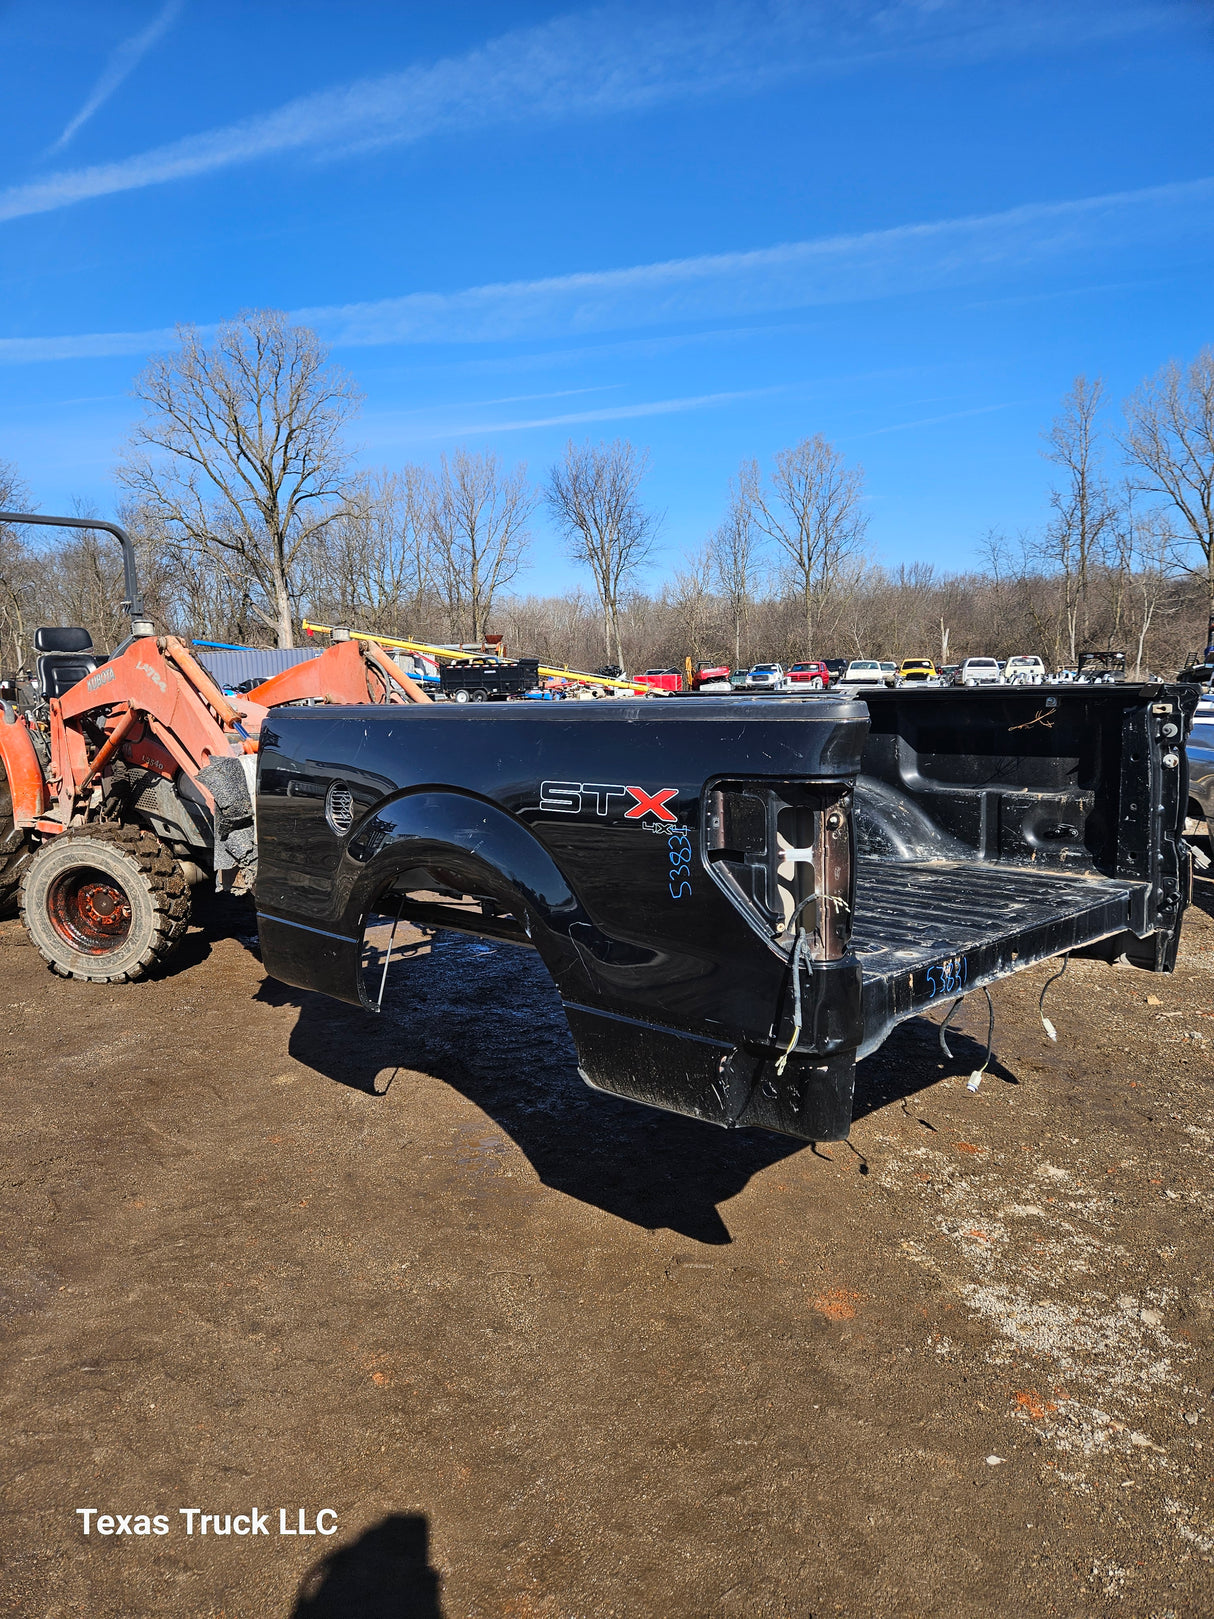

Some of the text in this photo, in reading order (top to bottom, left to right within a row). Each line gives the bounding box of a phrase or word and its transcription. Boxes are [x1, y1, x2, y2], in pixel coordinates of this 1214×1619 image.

[87, 667, 116, 692] KUBOTA
[142, 754, 164, 770] L3540
[539, 780, 680, 822] STX
[926, 956, 968, 998] 53831
